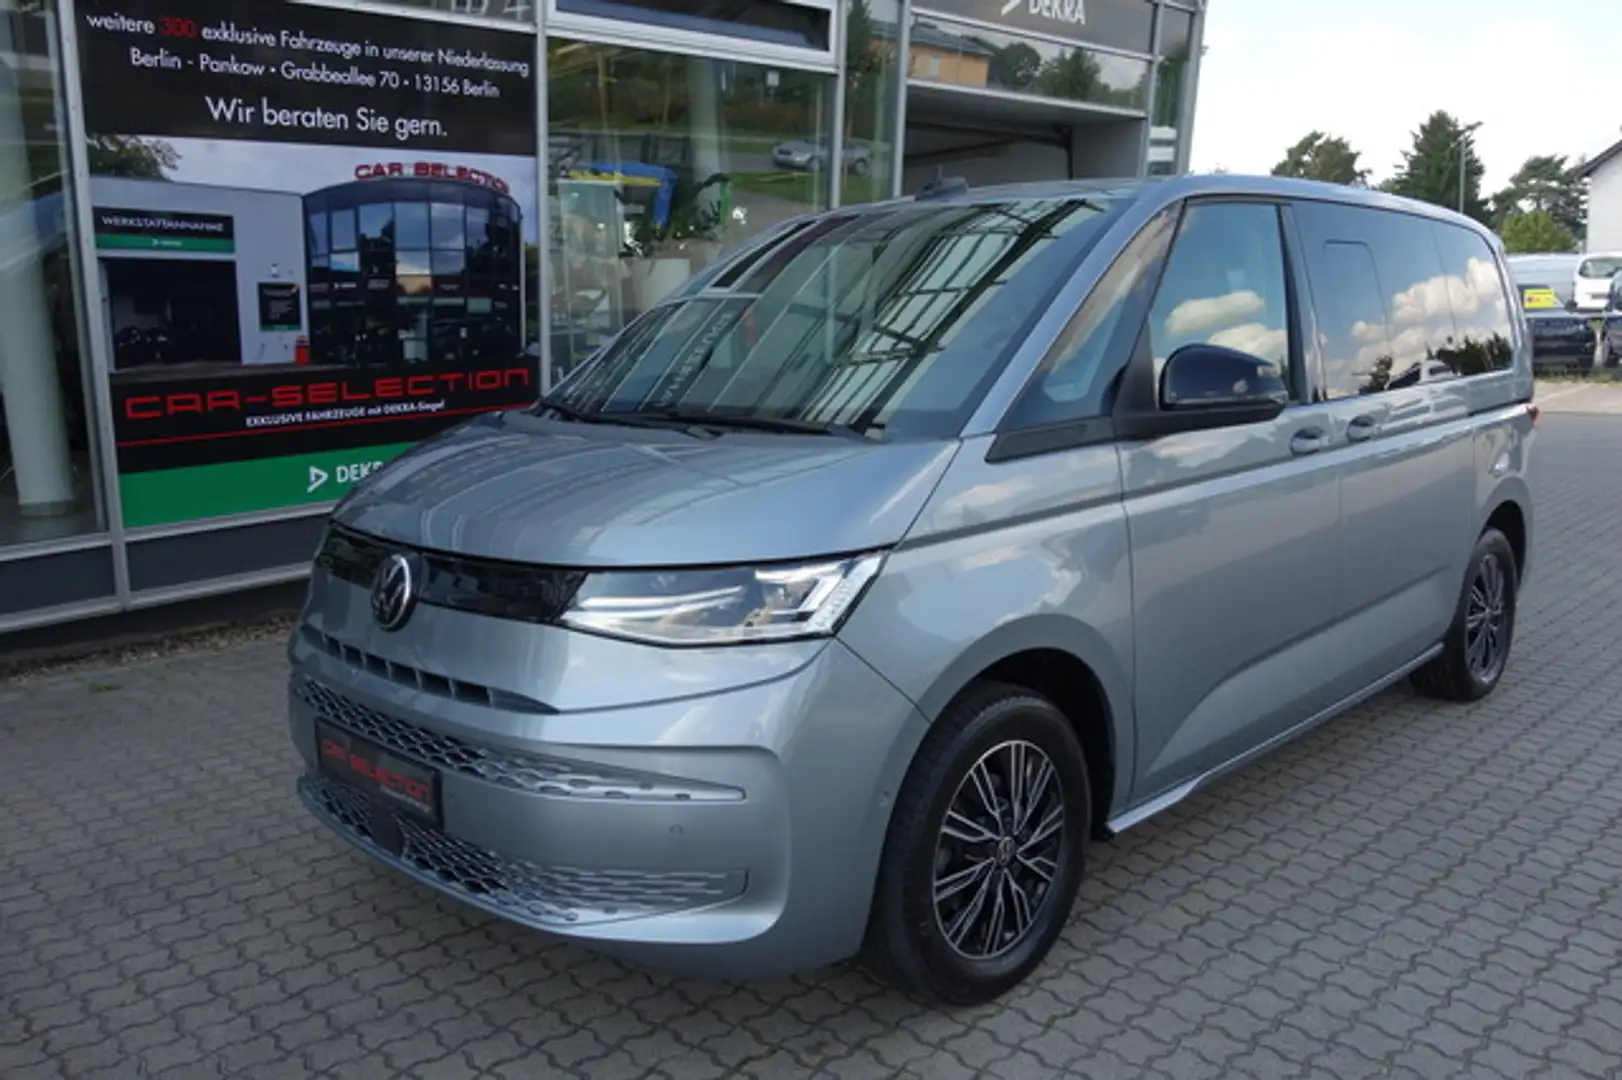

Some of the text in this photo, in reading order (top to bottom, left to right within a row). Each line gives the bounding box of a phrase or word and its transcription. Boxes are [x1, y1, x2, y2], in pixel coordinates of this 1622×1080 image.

[1029, 0, 1086, 26] DEKRA
[86, 13, 530, 78] weitere 300 exklusive Fahrzeuge in unserer Niederlassung
[130, 47, 182, 68] Berlin
[200, 53, 265, 76] Pankow
[281, 61, 376, 87] Grabbeallee
[379, 70, 400, 88] 70
[414, 74, 461, 95] 13156
[463, 79, 500, 97] Berlin
[205, 96, 448, 141] Wir beraten Sie gern.
[355, 163, 404, 180] CAR
